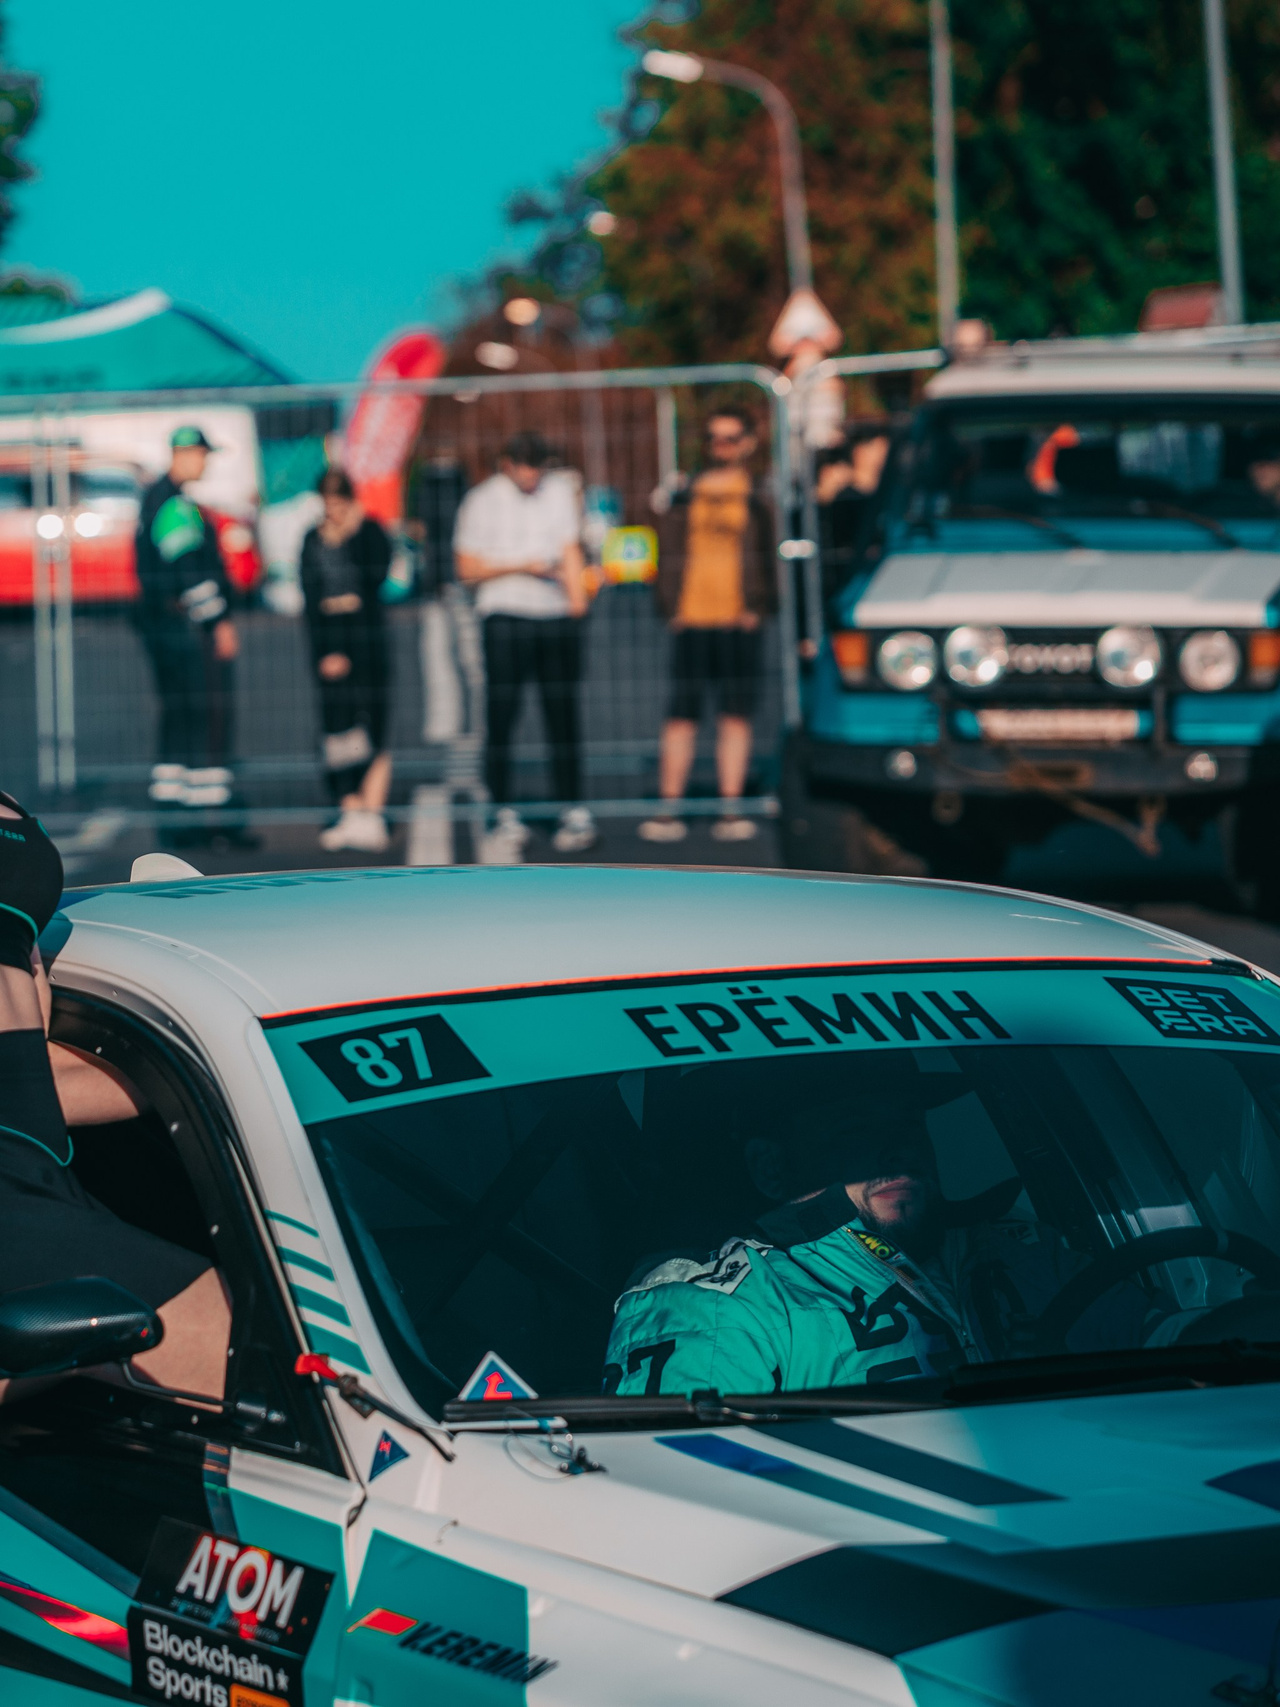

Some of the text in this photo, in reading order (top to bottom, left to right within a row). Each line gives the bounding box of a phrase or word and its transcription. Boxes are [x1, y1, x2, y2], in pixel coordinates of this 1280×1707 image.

[622, 985, 1013, 1058] ЕРЁМИН
[1126, 985, 1232, 1013] BET
[340, 1027, 433, 1088] 87
[176, 1535, 304, 1628] ATOM
[143, 1618, 275, 1690] Blockchain
[146, 1655, 229, 1707] Sports
